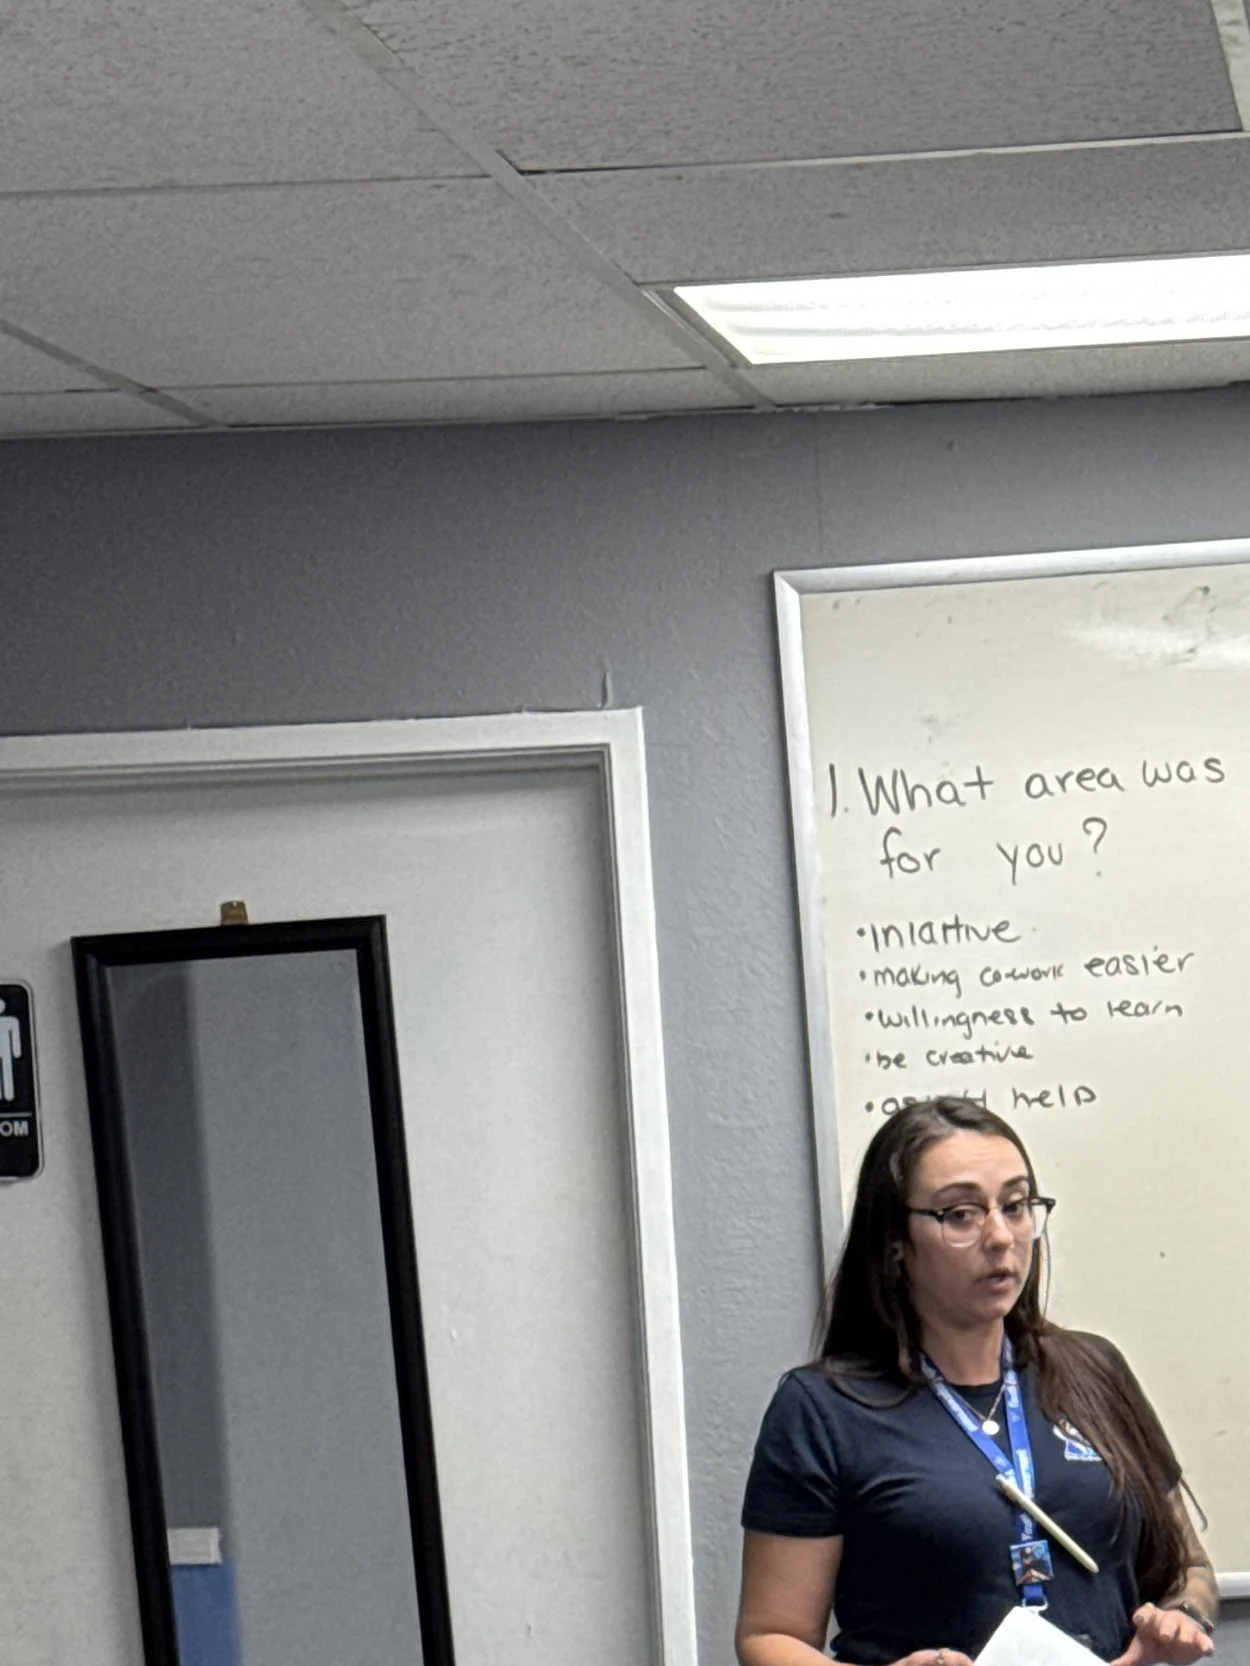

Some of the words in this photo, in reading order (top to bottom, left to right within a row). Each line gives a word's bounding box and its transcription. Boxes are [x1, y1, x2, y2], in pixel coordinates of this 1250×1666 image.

[829, 763, 850, 818] 1.
[858, 764, 994, 816] What
[1024, 766, 1125, 799] area
[1142, 756, 1226, 788] was
[880, 826, 941, 879] for
[874, 965, 962, 998] making
[1084, 945, 1194, 978] easier
[878, 1005, 1035, 1040] willingness
[1051, 1002, 1087, 1024] to
[1107, 1000, 1183, 1018] learn
[876, 1051, 907, 1069] be
[926, 1041, 1034, 1066] creative
[1012, 1084, 1097, 1110] help
